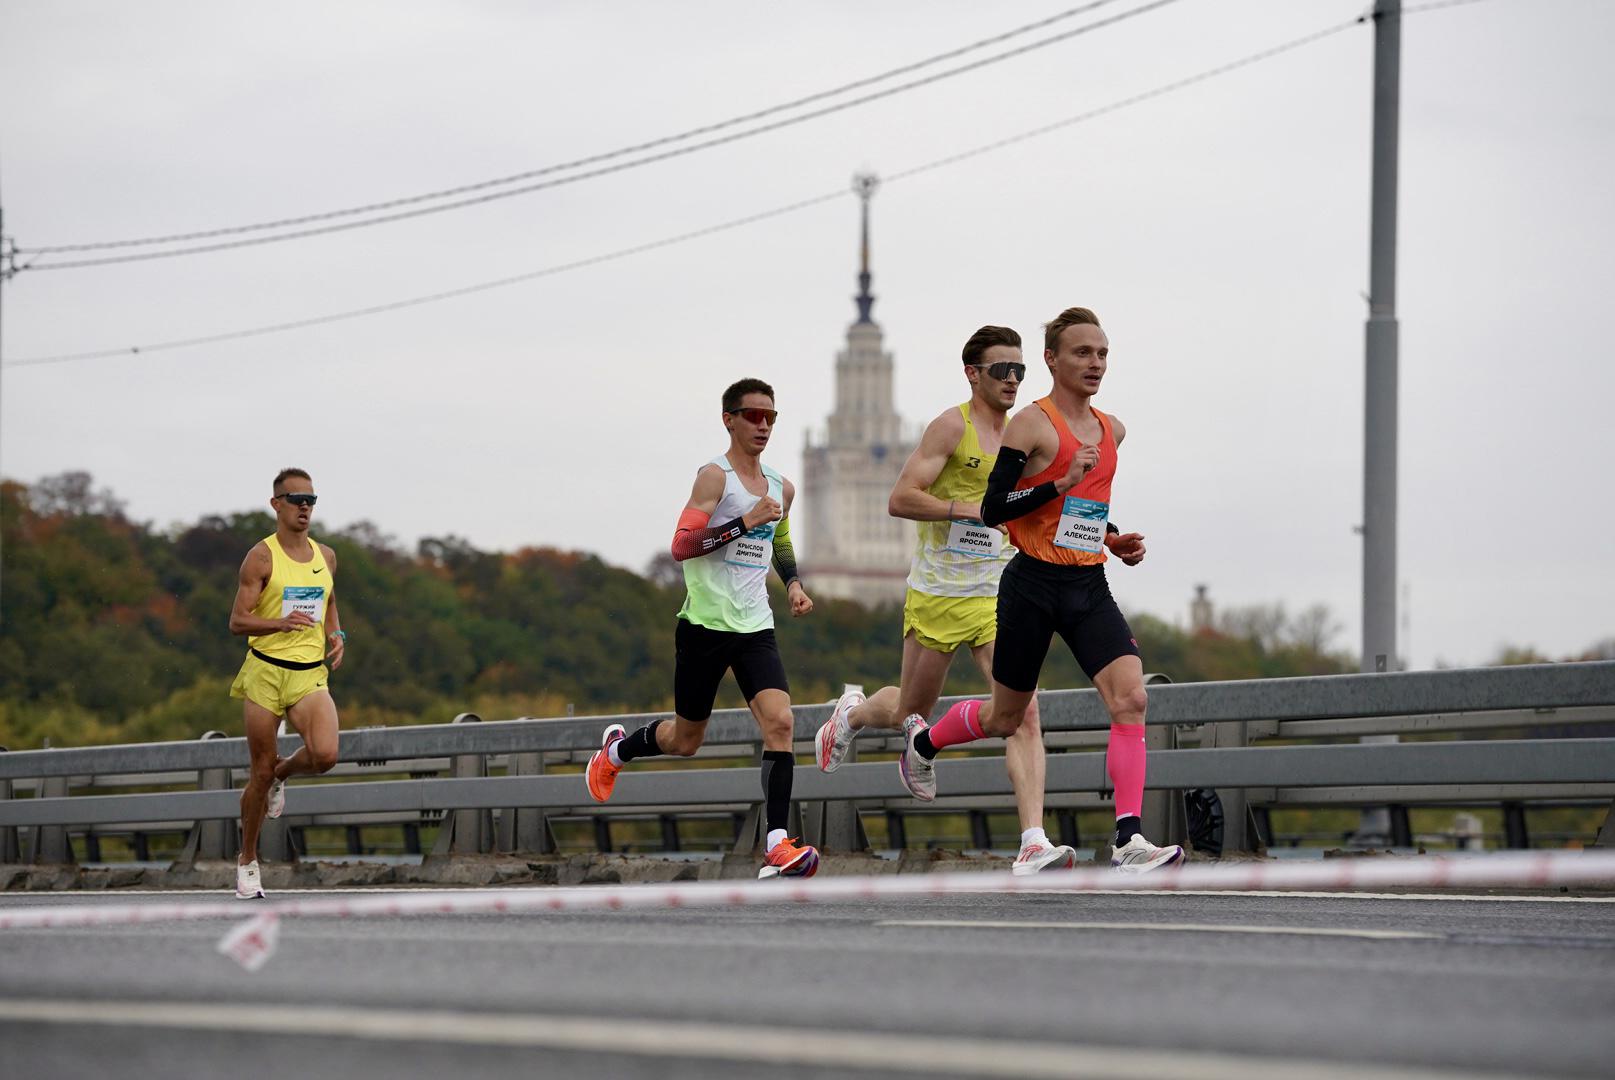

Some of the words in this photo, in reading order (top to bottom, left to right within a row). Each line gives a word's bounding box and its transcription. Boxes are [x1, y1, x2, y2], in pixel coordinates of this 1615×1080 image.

[1073, 523, 1099, 533] ОЛЬКОВ
[965, 531, 990, 539] БЯКИН
[1064, 530, 1101, 542] АЛЕКСАНДР
[737, 542, 764, 552] КРЫСЛОВ
[959, 537, 993, 547] ЯРОСЛАВ
[735, 549, 763, 558] ДМИТРИЙ
